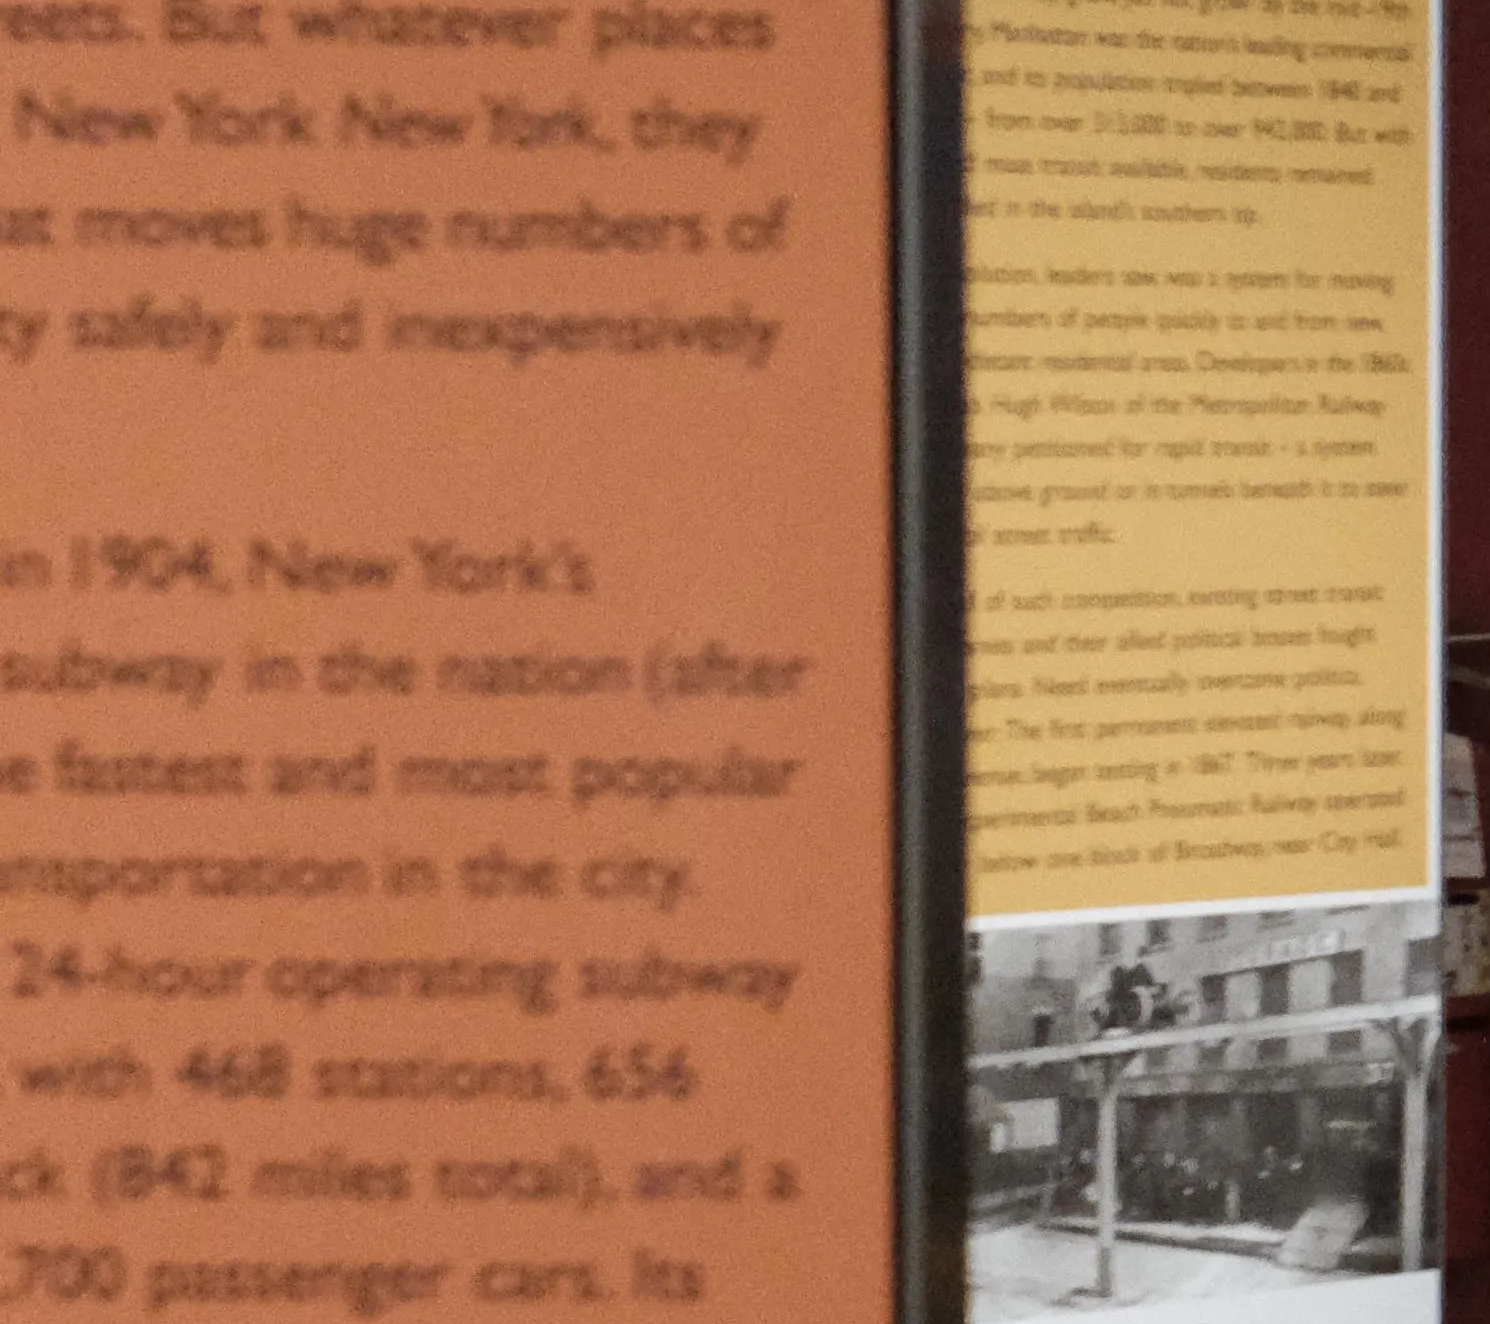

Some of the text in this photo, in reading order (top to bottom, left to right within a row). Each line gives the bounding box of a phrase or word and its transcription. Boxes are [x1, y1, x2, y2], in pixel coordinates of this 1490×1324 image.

[252, 298, 364, 355] and
[318, 640, 420, 696] the
[267, 742, 377, 798] and
[458, 843, 562, 899] the
